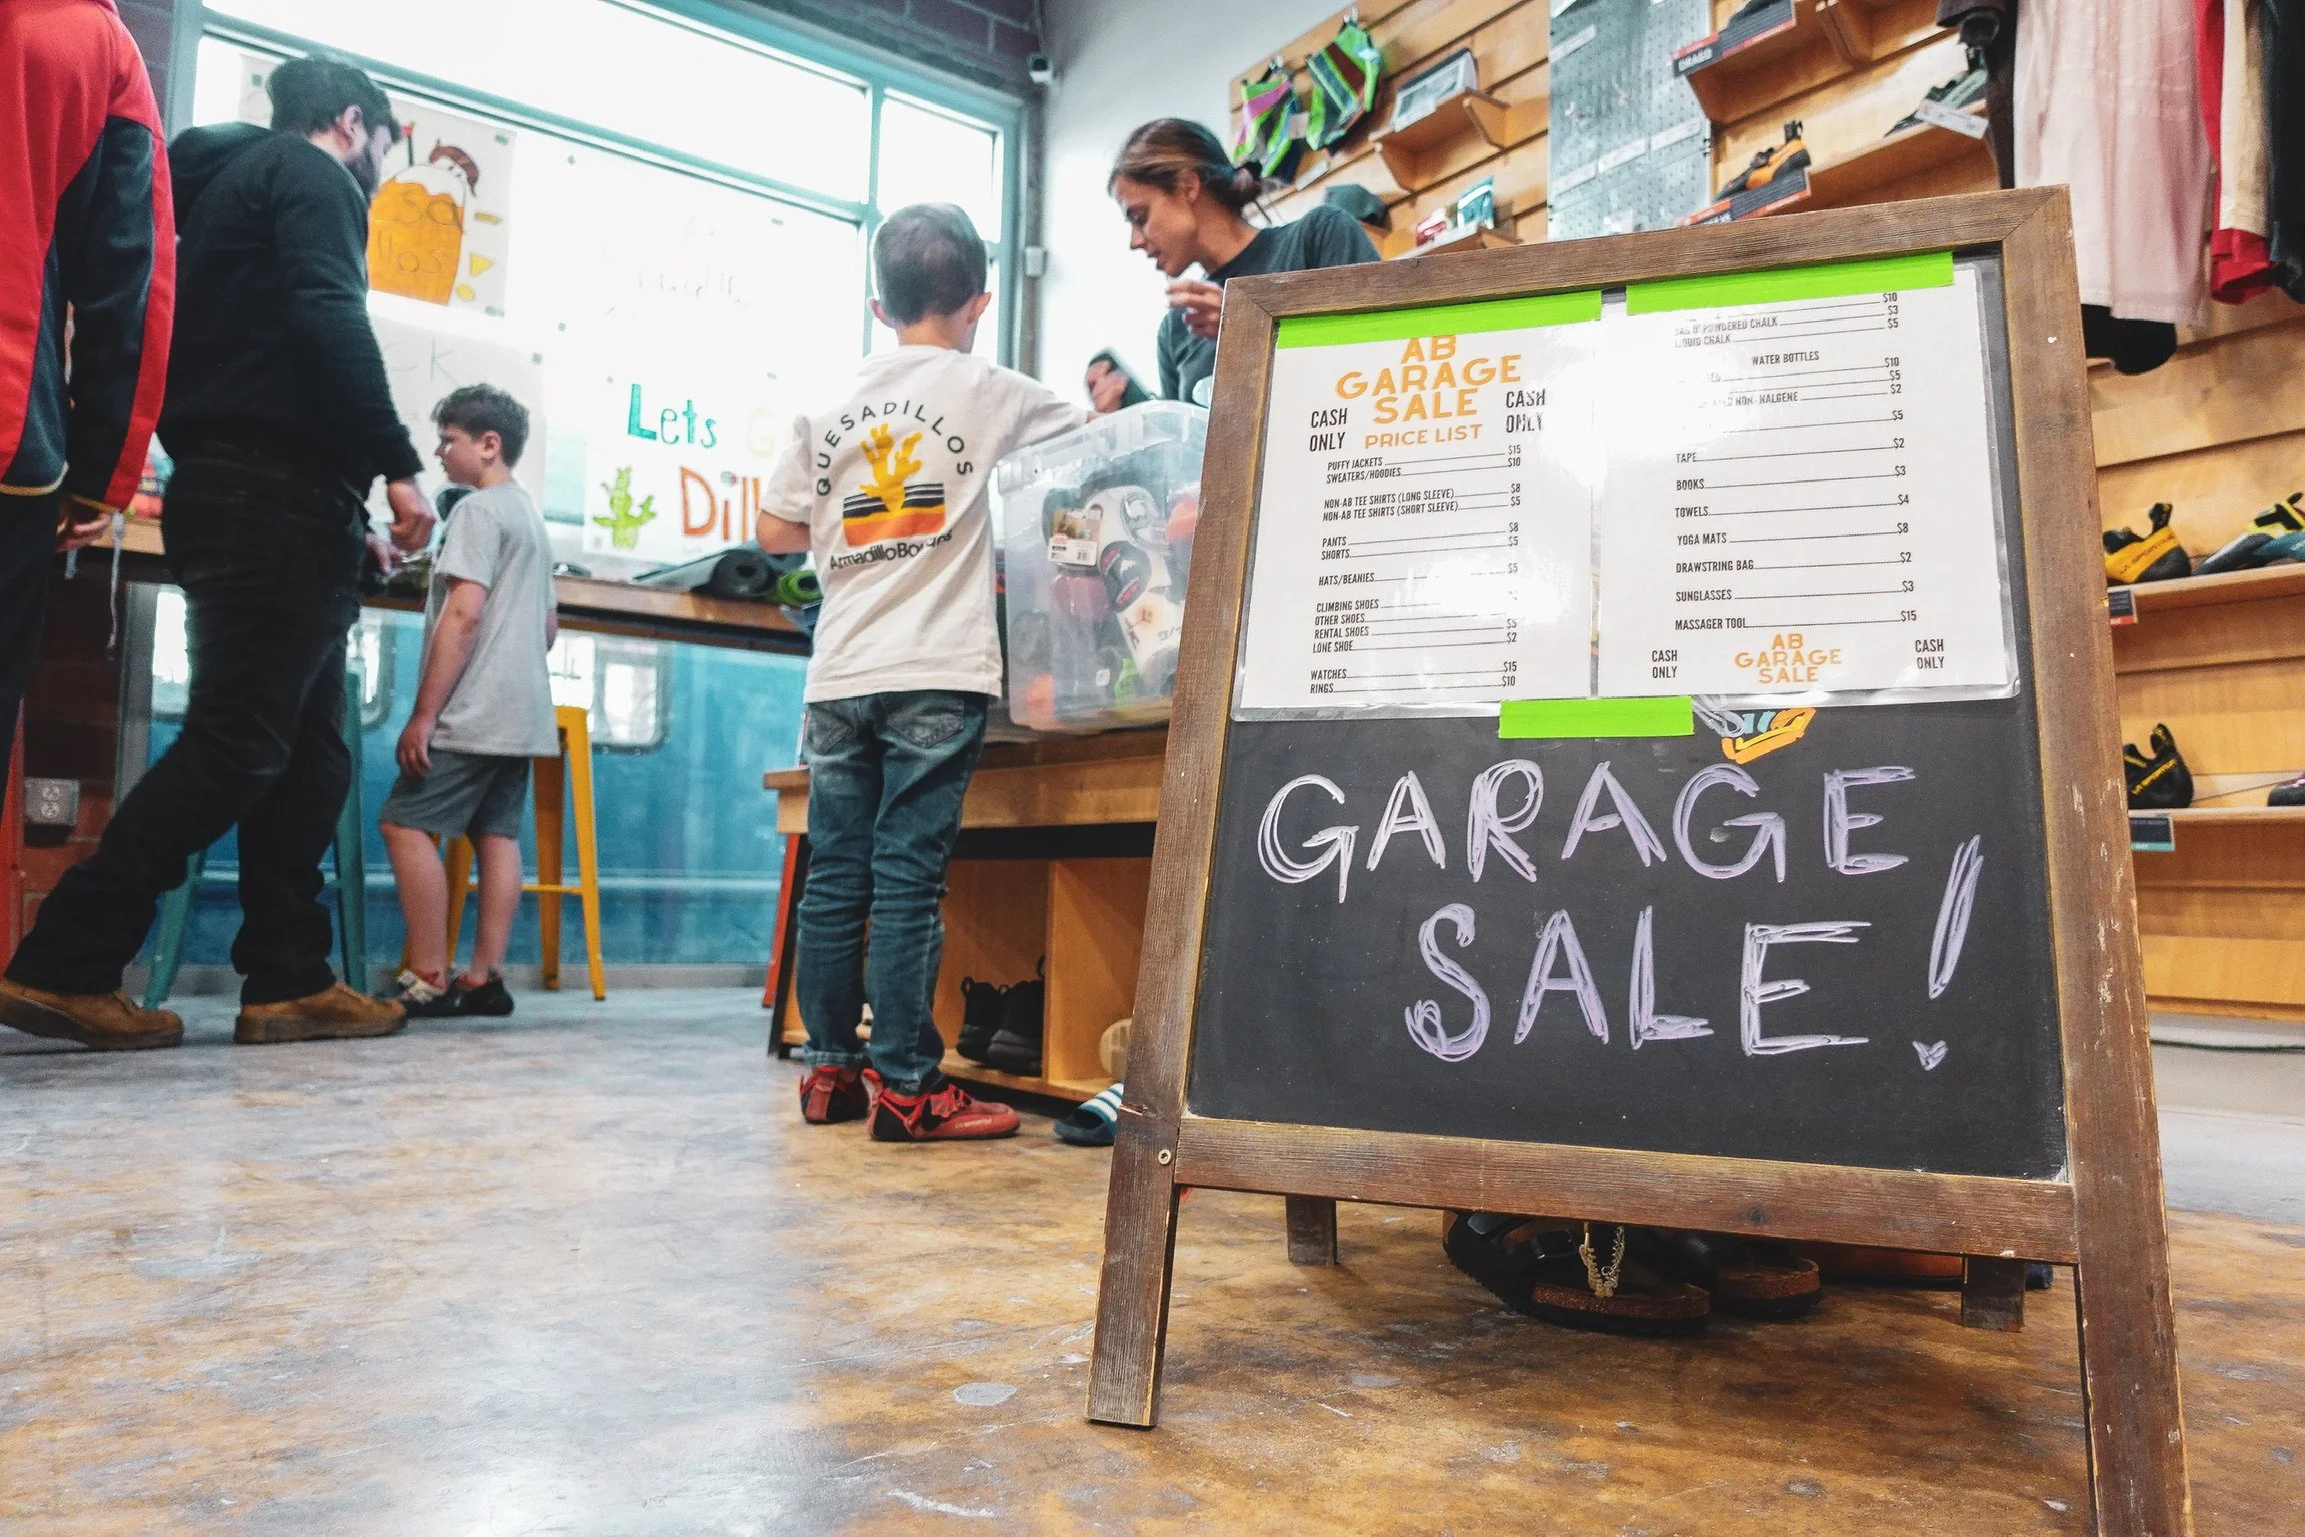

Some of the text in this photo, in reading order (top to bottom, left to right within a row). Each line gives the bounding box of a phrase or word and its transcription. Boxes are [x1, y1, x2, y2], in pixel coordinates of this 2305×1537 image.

[1883, 292, 1899, 303] $10
[1749, 316, 1778, 329] CHALK
[1887, 305, 1899, 316] $3
[1675, 318, 1899, 348] LQUID CHALK $5
[1400, 333, 1457, 364] AB
[1751, 350, 1820, 366] WATER BOTTLES
[1884, 357, 1900, 368] $10
[1336, 354, 1522, 400] GARAGE
[1889, 370, 1901, 381] $5
[1505, 388, 1546, 408] CASH
[1890, 384, 1902, 395] $2
[627, 383, 717, 448] Lets
[1373, 388, 1479, 424] SALE
[1892, 410, 1904, 421] $5
[1311, 407, 1348, 429] CASH
[1309, 432, 1346, 452] ONLY
[1364, 423, 1484, 449] PRICE LIST
[816, 400, 973, 496] QUESADILLOS
[1327, 444, 1522, 472] PUFFY JACKETS $15
[1675, 438, 1905, 464] TAPE $2
[1326, 457, 1521, 485] SWEATERS/HOODIES $10
[1676, 465, 1907, 491] BOOKS $3
[1324, 483, 1521, 509] NON-AB TEE SHIRTS (LONG SLEEVE) $8
[1674, 493, 1910, 518] TOWELS $4
[1323, 496, 1521, 522] NON-AB TEE SHIRTS (SHORT SLEEVE) $5
[1322, 522, 1519, 548] PANTS $8
[1677, 522, 1909, 546] YOGA MATS $8
[1321, 536, 1519, 560] SHORTS $5
[1675, 551, 1912, 573] DRAWSTRING BAG $2
[1318, 572, 1375, 586] HATS/BEANIES
[1675, 580, 1915, 602] SUNGLASSES $3
[1316, 598, 1380, 613] CLIMBING SHOES
[1314, 613, 1365, 626] OTHER SHOES
[1674, 610, 1917, 631] MASSAGER TOOL $15
[1312, 632, 1518, 654] LONE SHOE $2
[1314, 627, 1343, 639] RENTAL
[1344, 626, 1370, 638] SHOES
[1771, 632, 1804, 650] AB
[1652, 649, 1678, 663] CASH
[1914, 638, 1945, 653] CASH
[1734, 648, 1843, 669] GARAGE
[1916, 656, 1945, 669] ONLY
[1310, 661, 1518, 681] WATCHES $15
[1652, 666, 1678, 679] ONLY
[1758, 666, 1819, 684] SALE
[1310, 675, 1516, 694] RINGS $10
[1256, 758, 1917, 903] GARAGE
